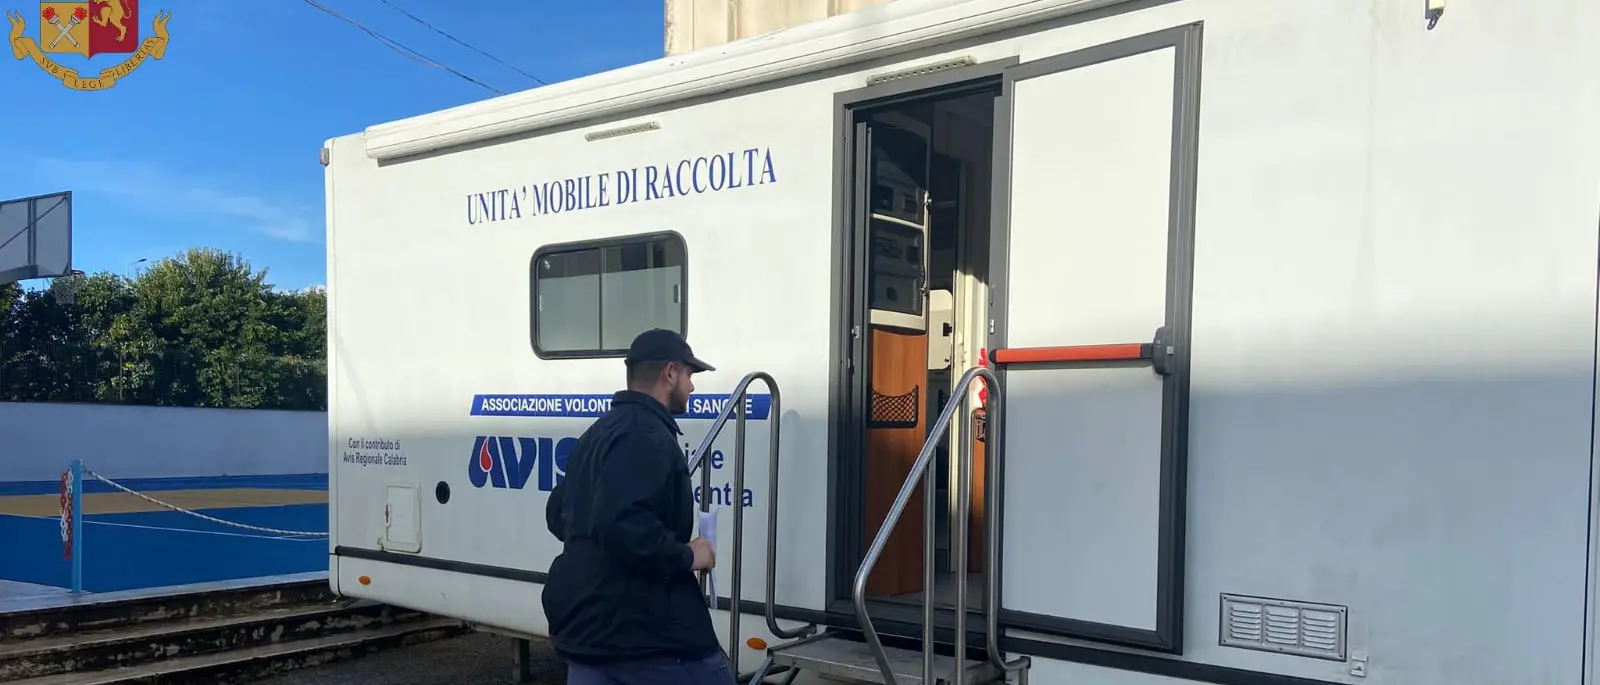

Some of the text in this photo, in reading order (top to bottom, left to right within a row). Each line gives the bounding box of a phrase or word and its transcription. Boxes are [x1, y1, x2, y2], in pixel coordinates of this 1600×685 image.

[533, 172, 610, 217] MOBILE
[616, 168, 638, 205] DI
[644, 145, 777, 200] RACCOLTA
[481, 397, 563, 412] ASSOCIAZIONE
[565, 397, 612, 413] VOLONT
[693, 398, 753, 414] SANE
[348, 437, 360, 449] Con
[365, 438, 394, 450] contributo
[394, 438, 401, 451] di
[343, 451, 407, 467] Avis Regionale Calabria
